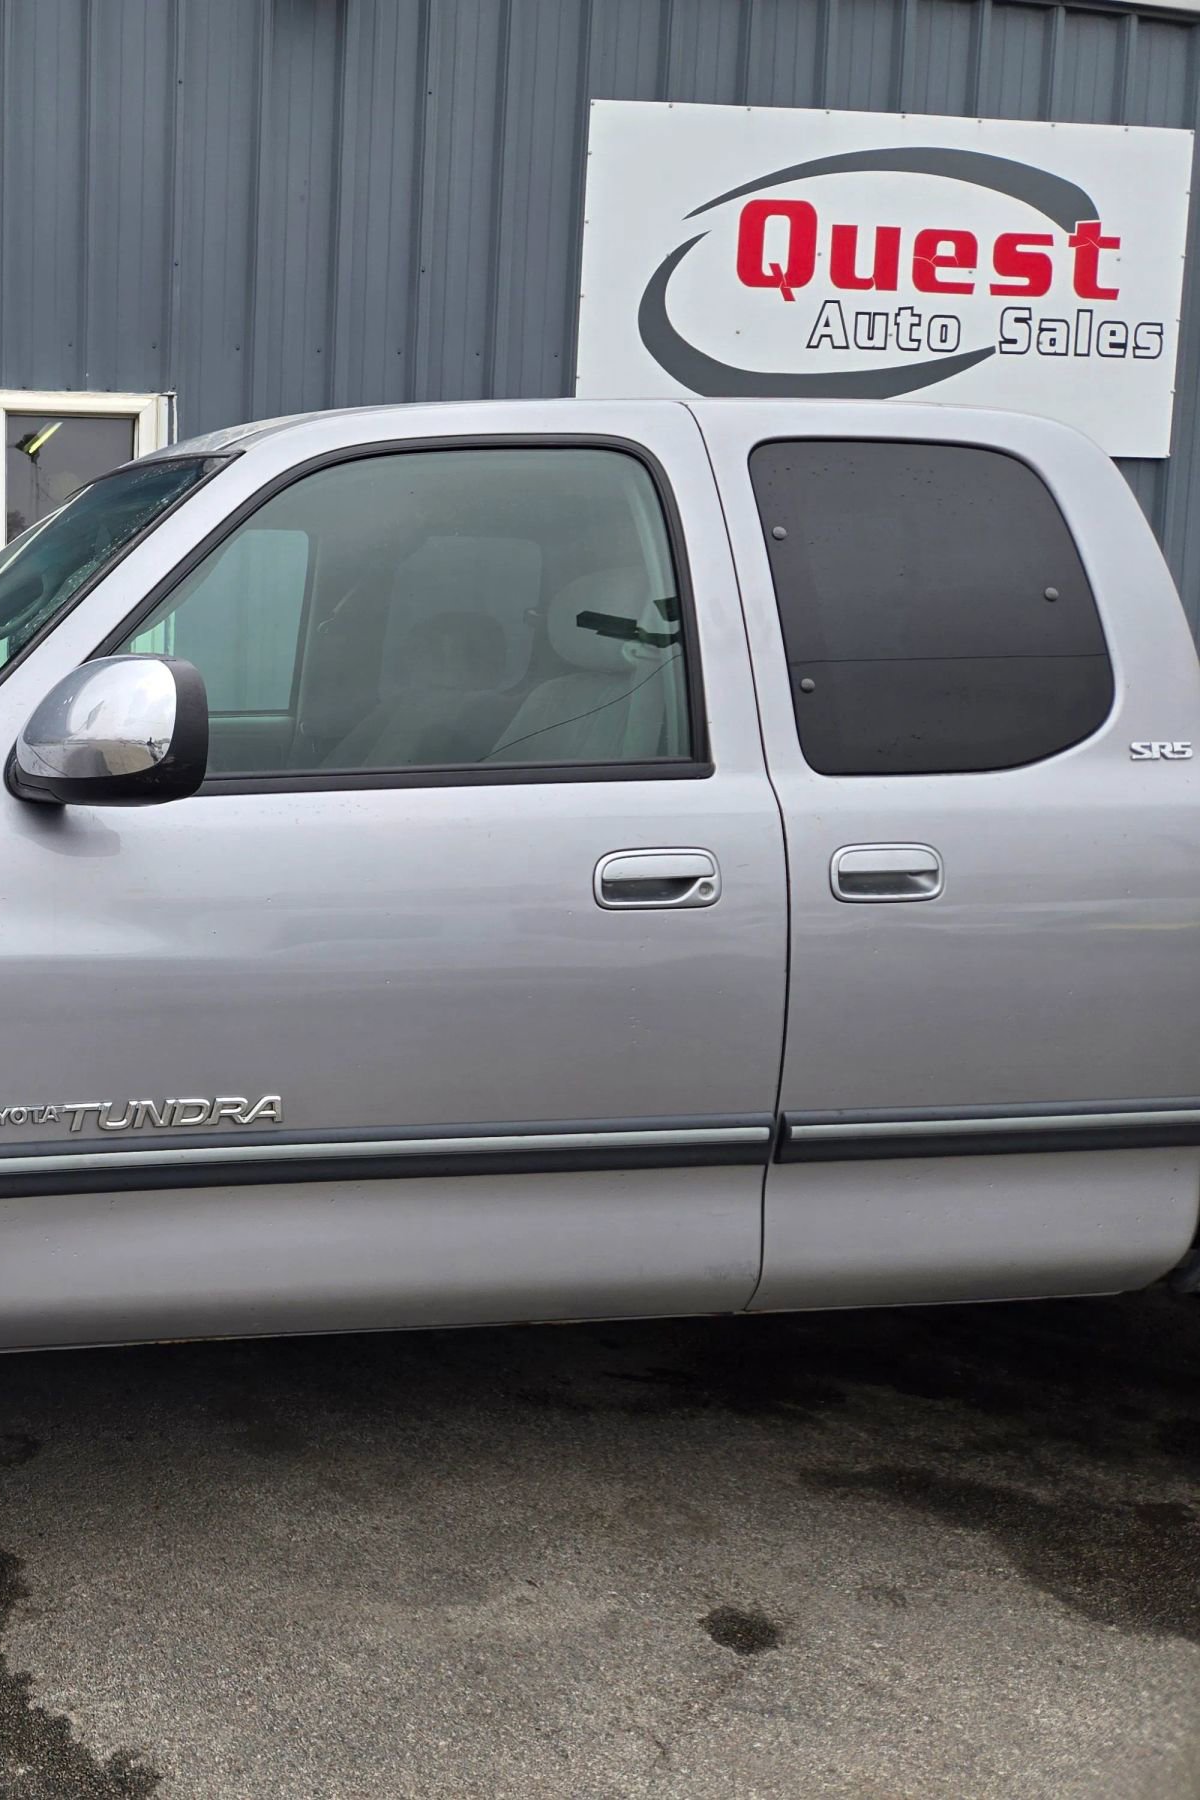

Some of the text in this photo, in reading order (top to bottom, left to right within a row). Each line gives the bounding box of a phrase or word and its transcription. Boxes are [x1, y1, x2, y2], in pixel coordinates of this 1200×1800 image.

[736, 199, 1121, 302] Quest
[805, 300, 1165, 360] Auto Sales
[1129, 741, 1193, 760] SR5
[64, 1095, 283, 1132] TUNDRA
